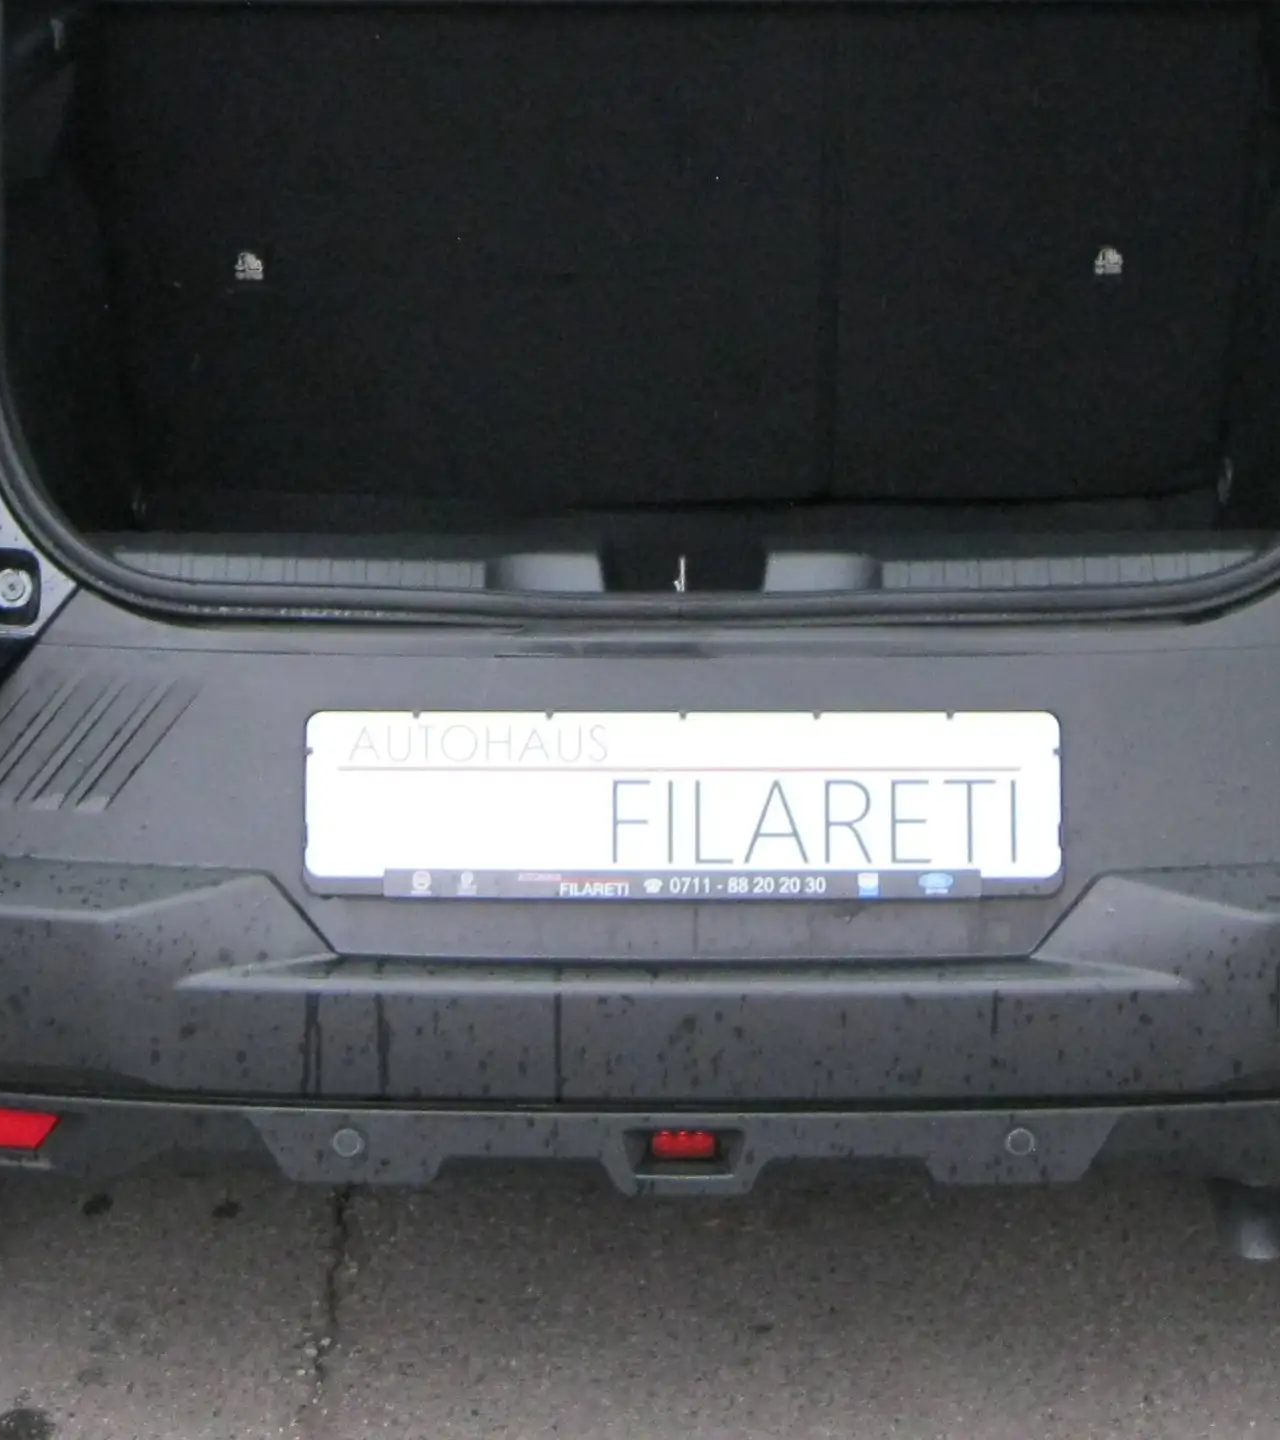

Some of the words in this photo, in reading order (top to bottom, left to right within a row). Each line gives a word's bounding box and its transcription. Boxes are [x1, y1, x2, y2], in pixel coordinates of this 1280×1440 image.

[349, 724, 609, 763] AUTOHAUS
[611, 779, 1021, 865] FILARETI
[560, 882, 629, 896] FILARETI
[669, 877, 712, 895] 0711
[727, 877, 749, 895] 88
[753, 877, 775, 895] 20
[779, 877, 801, 895] 20
[804, 877, 826, 895] 30
